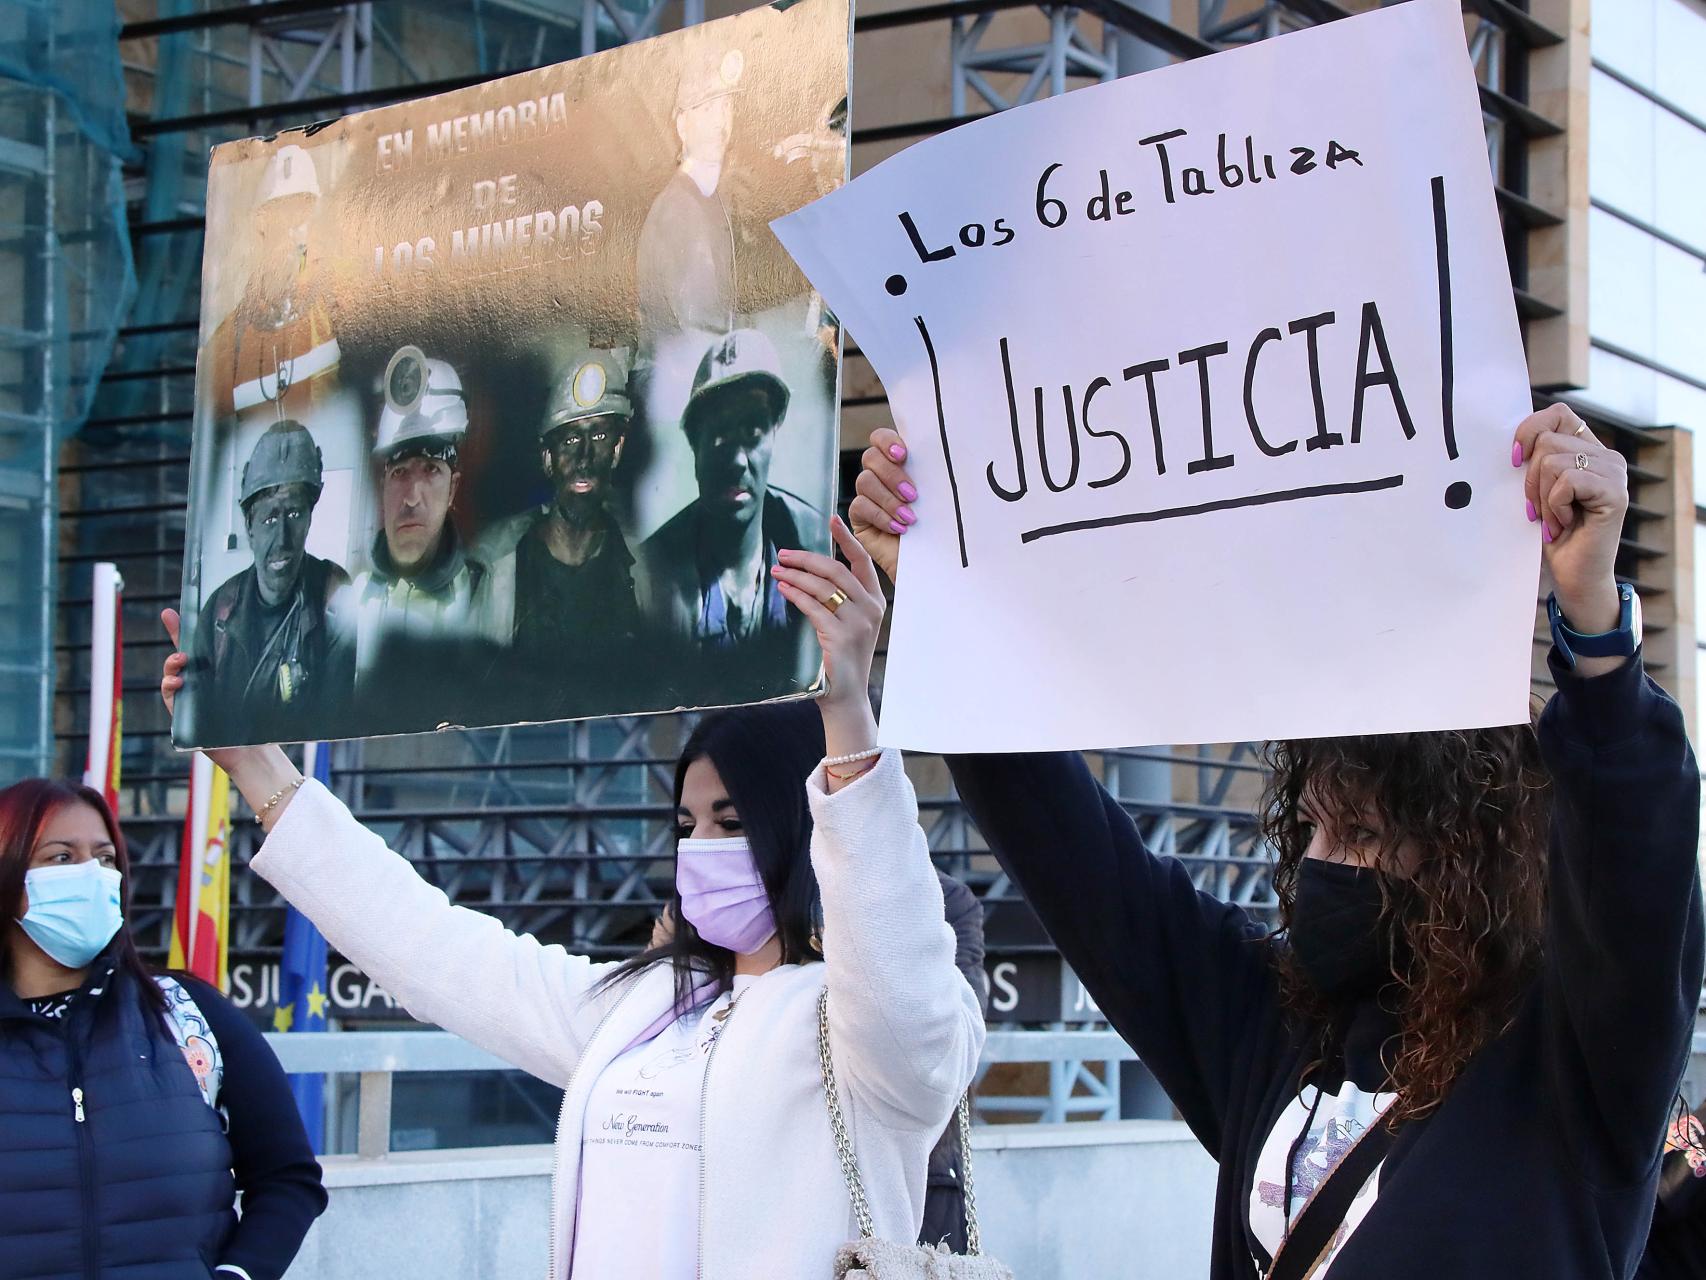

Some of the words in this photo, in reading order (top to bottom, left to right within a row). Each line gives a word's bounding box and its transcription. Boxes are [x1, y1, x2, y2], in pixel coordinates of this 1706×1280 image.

[376, 128, 414, 175] EN
[426, 92, 568, 165] MEMORIA
[472, 173, 517, 211] DE
[898, 212, 1015, 264] Los
[1036, 163, 1067, 229] 6
[1086, 169, 1136, 222] de
[451, 199, 604, 279] MINEROS
[632, 1089, 650, 1097] FIGHT
[625, 1114, 669, 1138] Generation
